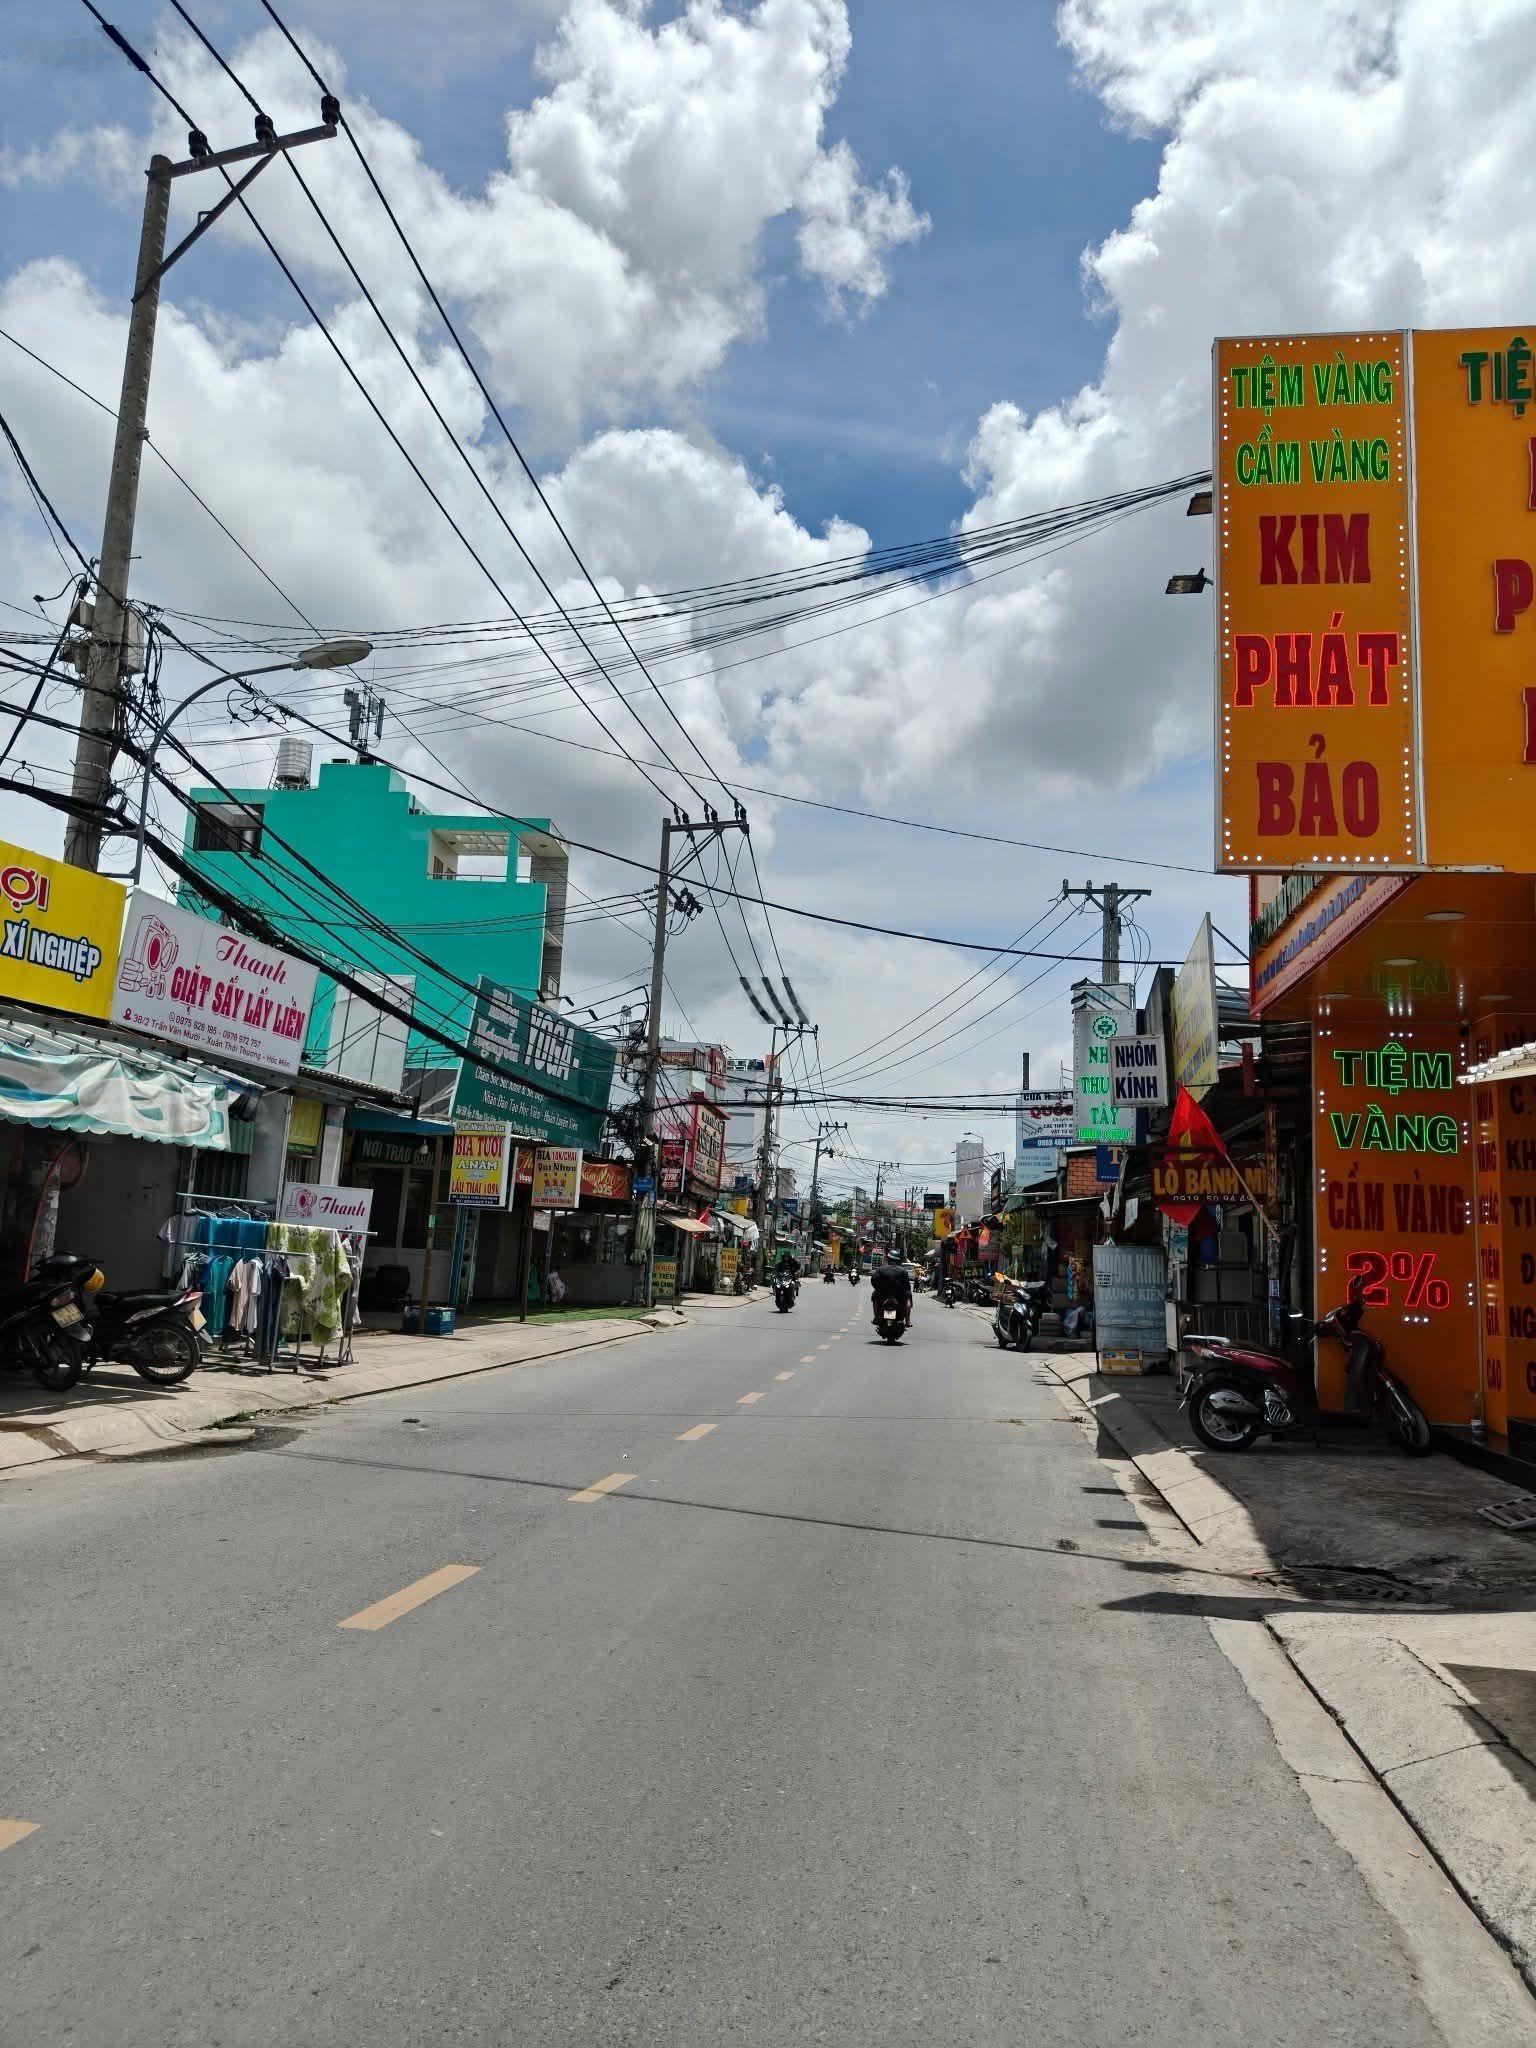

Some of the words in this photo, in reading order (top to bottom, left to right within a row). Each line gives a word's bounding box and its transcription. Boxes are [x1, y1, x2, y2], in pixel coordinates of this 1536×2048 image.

[1231, 354, 1304, 416] TIỆM
[1312, 351, 1393, 407] VÀNG
[1235, 424, 1301, 487] CẦM
[1310, 428, 1391, 484] VÀNG
[1259, 513, 1371, 585] KIM
[1233, 611, 1400, 708] PHÁT
[1257, 733, 1380, 838] BẢO
[2, 919, 29, 960] XÍ
[28, 928, 101, 982] NGHIỆP
[216, 935, 287, 985] Thanh
[170, 964, 212, 1016] GIẶT
[212, 975, 244, 1020] SẤY
[243, 986, 274, 1030] LẤY
[272, 996, 306, 1041] LIỀN
[1115, 1040, 1157, 1068] NHÔM
[1333, 1042, 1453, 1095] TIỆM
[1090, 1102, 1120, 1125] TÂY
[1115, 1072, 1158, 1099] KÍNH
[455, 1135, 473, 1156] BIA
[1330, 1104, 1458, 1154] VÀNG
[319, 1196, 365, 1217] Thanh
[1153, 1161, 1179, 1196] LÒ
[1185, 1161, 1239, 1195] BÁNH
[1393, 1169, 1465, 1235] VÀNG
[1345, 1250, 1450, 1310] 2%
